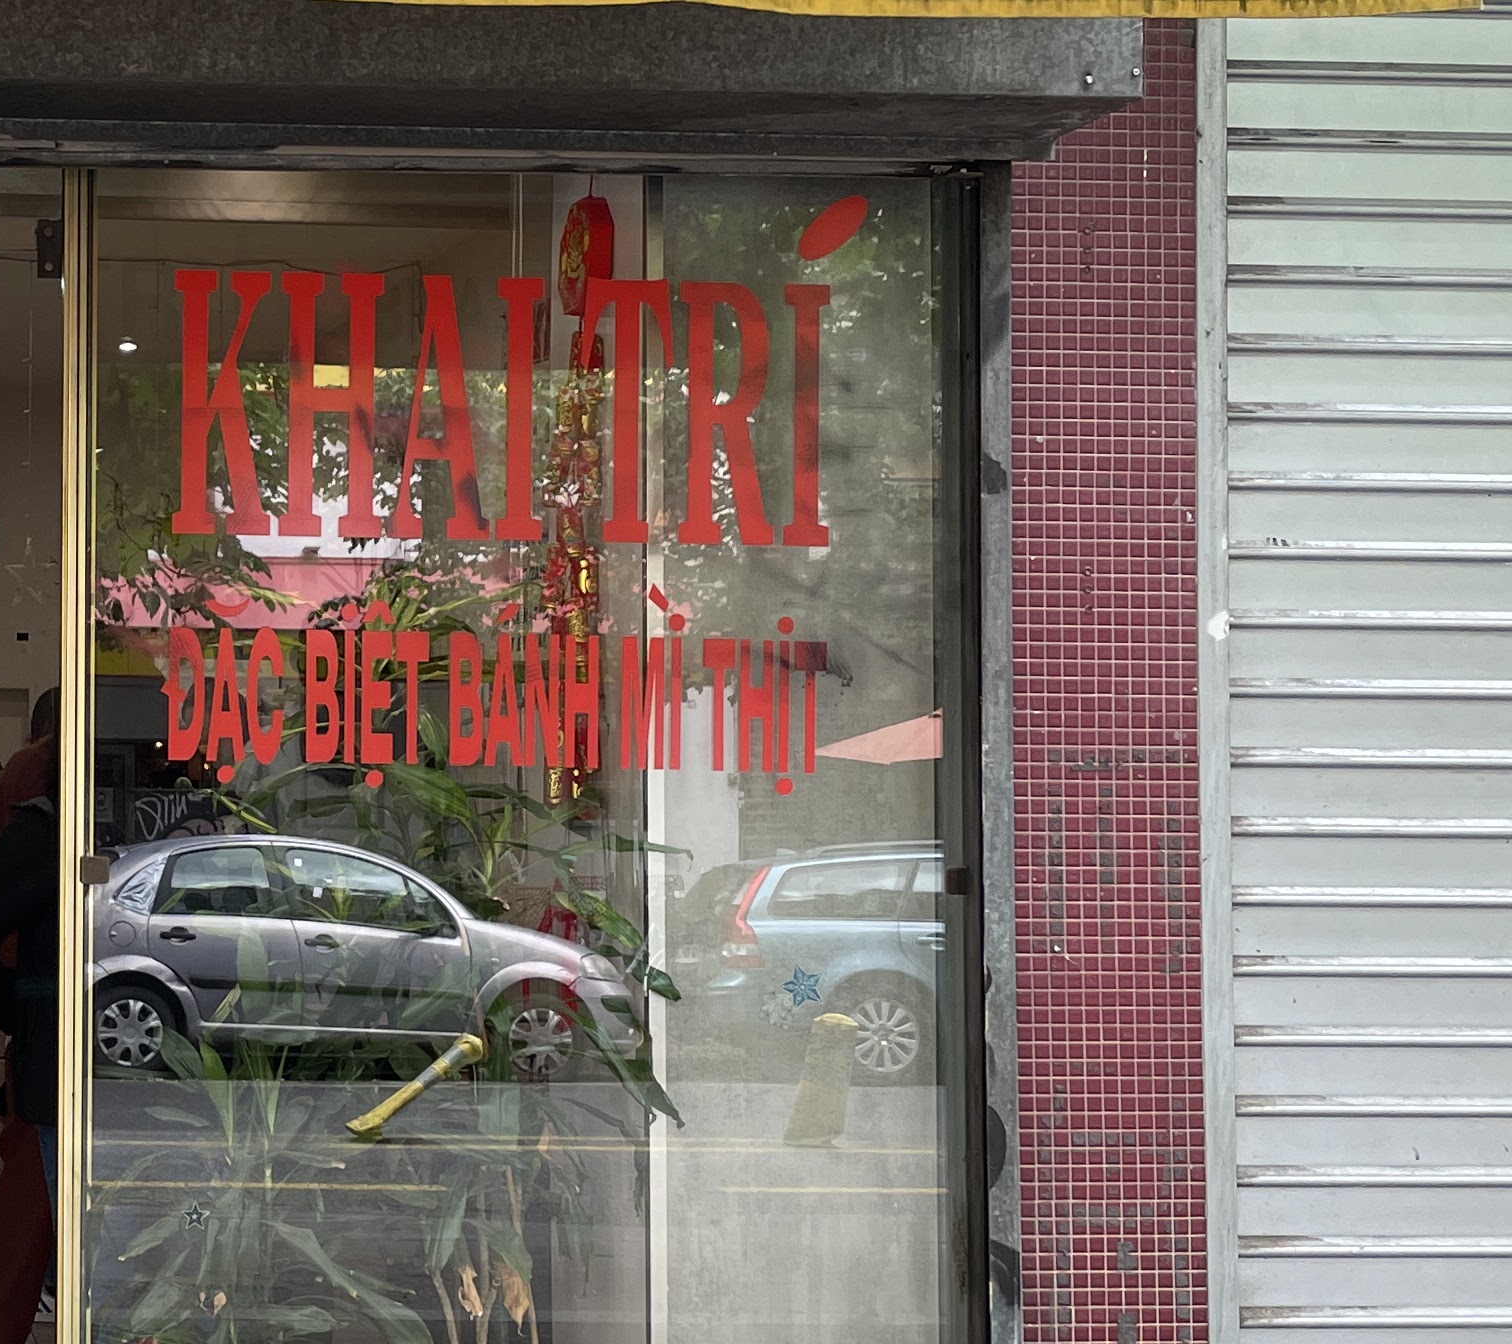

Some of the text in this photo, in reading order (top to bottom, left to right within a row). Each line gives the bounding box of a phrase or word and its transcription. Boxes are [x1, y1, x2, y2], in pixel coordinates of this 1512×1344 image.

[171, 269, 546, 541] KHAI
[160, 583, 829, 796] ĐẶC BIỆT BÁNH MÌ THỊT
